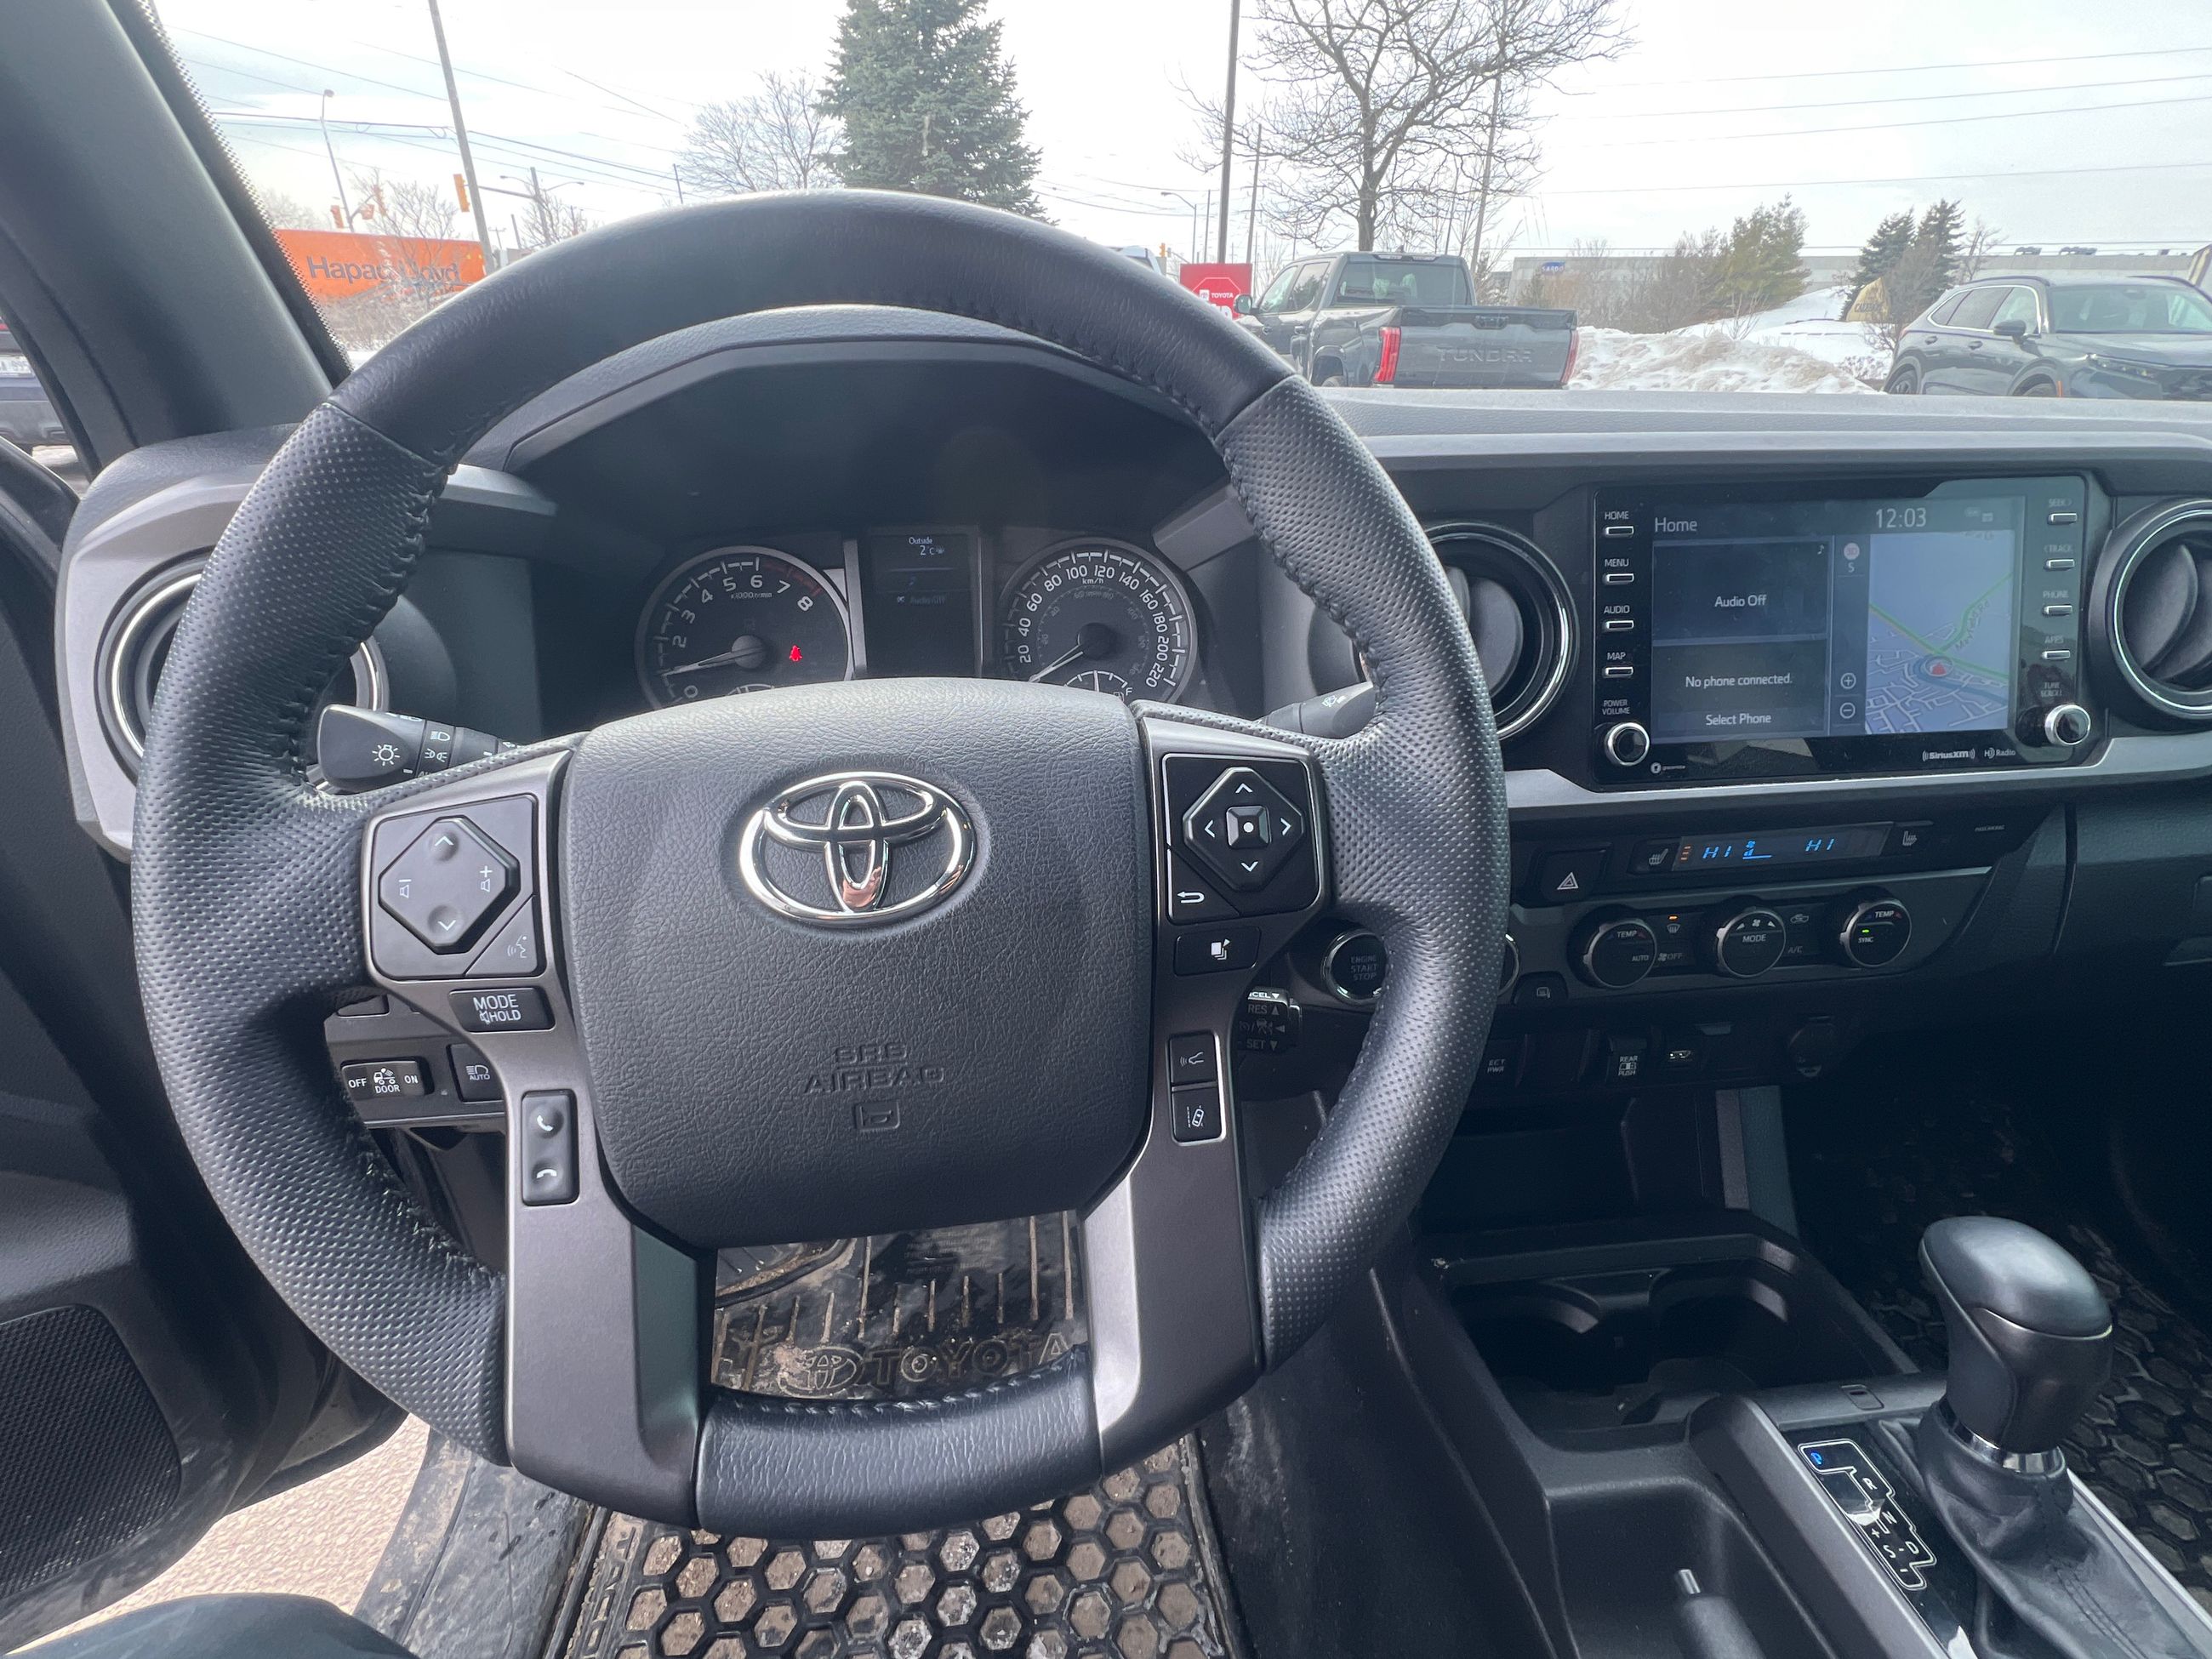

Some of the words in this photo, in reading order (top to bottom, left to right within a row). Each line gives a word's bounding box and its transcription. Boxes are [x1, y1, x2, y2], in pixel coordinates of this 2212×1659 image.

[1436, 345, 1533, 362] TUNDRA
[1604, 510, 1630, 520] HOME
[1875, 507, 1927, 528] 12:03
[1654, 516, 1698, 533] Home
[908, 536, 933, 545] Outside
[1604, 558, 1630, 567] MENU
[1847, 562, 1856, 573] S
[1065, 564, 1088, 580] 100
[1093, 564, 1116, 579] 120
[722, 576, 738, 592] 5
[750, 574, 763, 589] 6
[776, 579, 791, 594] 7
[1043, 573, 1063, 592] 80
[1118, 572, 1140, 590] 140
[701, 589, 714, 603] 4
[1026, 592, 1043, 613] 60
[1138, 589, 1159, 611] 160
[1714, 596, 1745, 607] Audio
[1747, 594, 1767, 607] Off
[796, 596, 814, 612] 8
[1603, 605, 1631, 614] AUDIO
[681, 609, 696, 624] 3
[1152, 611, 1168, 633] 180
[1018, 617, 1032, 637] 40
[672, 635, 687, 648] 2
[1156, 636, 1170, 661] 200
[1018, 644, 1032, 664] 20
[1606, 652, 1627, 661] MAP
[1145, 662, 1165, 688] 220
[1685, 676, 1702, 687] No
[1703, 676, 1736, 689] phone
[1737, 673, 1793, 686] connected.
[683, 685, 698, 698] 0
[1125, 687, 1133, 696] F
[1603, 698, 1628, 707] POWER
[1601, 707, 1631, 715] VOLUME
[1705, 714, 1737, 726] Select
[1739, 713, 1772, 724] Phone
[1927, 750, 1971, 760] SiriusXM
[1702, 845, 1732, 859] HI
[1805, 838, 1835, 852] HI
[1617, 930, 1638, 938] TEMP
[1742, 934, 1767, 943] MODE
[1787, 945, 1804, 954] A/C
[1350, 954, 1377, 964] ENGINE
[1351, 963, 1377, 972] START
[1353, 972, 1377, 981] STOP
[473, 994, 520, 1012] MODE
[1247, 1004, 1268, 1014] RES
[489, 1009, 522, 1022] HOLD
[1246, 1039, 1266, 1050] SET
[835, 1041, 908, 1064] SRS
[348, 1077, 368, 1089] OFF
[404, 1075, 419, 1085] ON
[469, 1072, 491, 1081] AUTO
[804, 1065, 946, 1094] AIRBAG
[374, 1084, 401, 1095] DOOR
[1810, 1452, 1823, 1465] P
[1862, 1477, 1878, 1491] R
[1882, 1511, 1898, 1525] N
[1883, 1544, 1896, 1559] S
[1905, 1541, 1919, 1555] D
